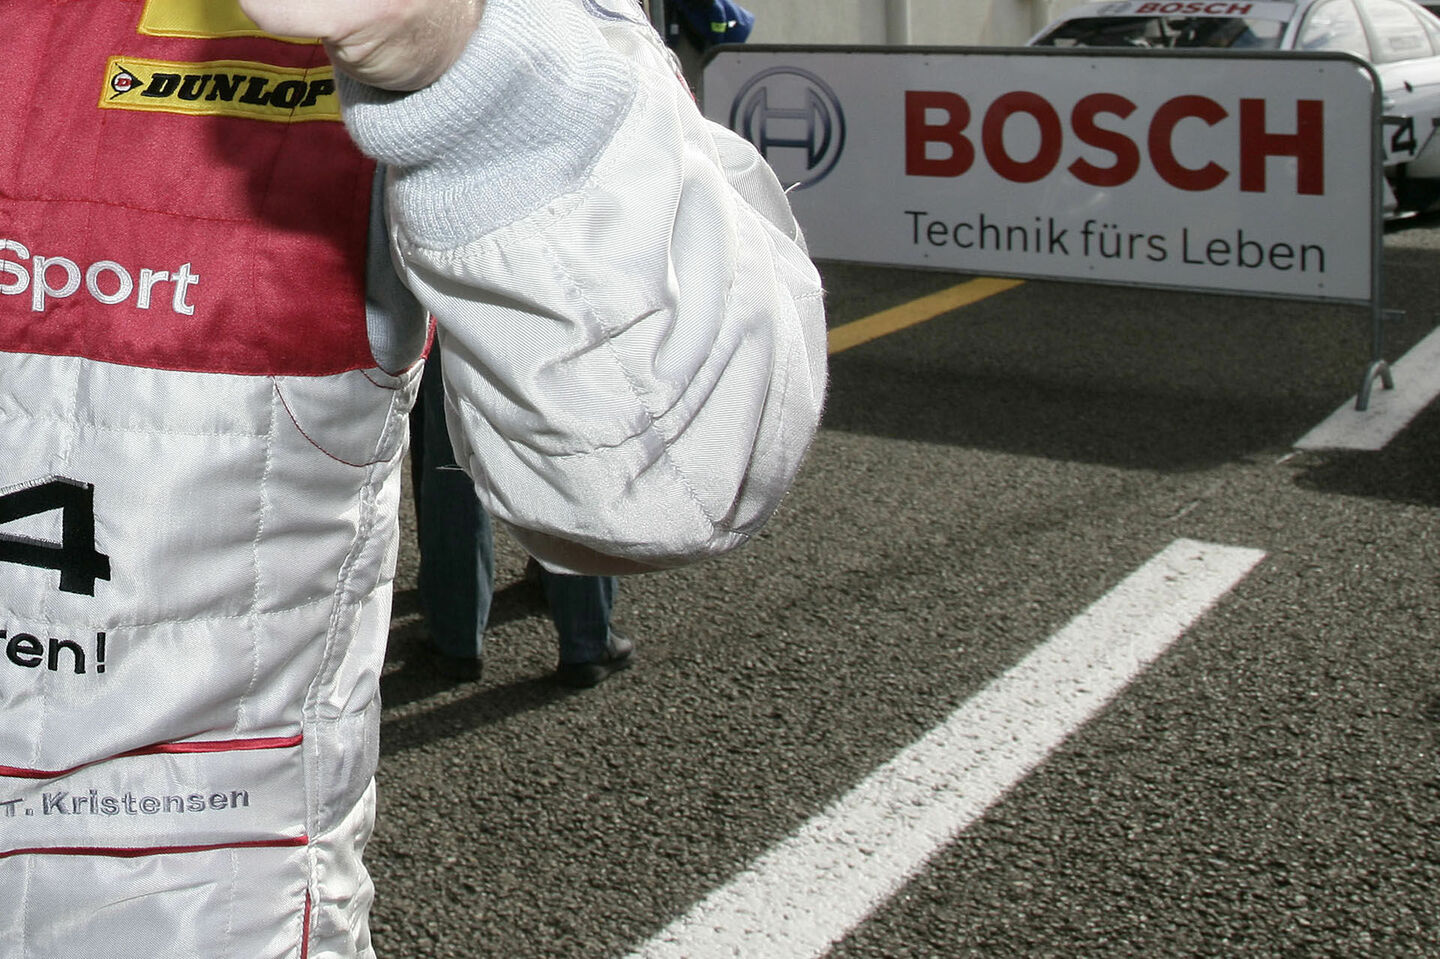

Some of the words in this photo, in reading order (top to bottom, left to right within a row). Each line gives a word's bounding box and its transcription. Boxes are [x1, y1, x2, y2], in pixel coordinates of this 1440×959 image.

[1135, 1, 1253, 15] BOSCH
[141, 72, 336, 109] DUNLOP
[904, 90, 1325, 196] BOSCH
[904, 210, 1069, 256] Technik
[1081, 219, 1168, 262] fürs
[1182, 227, 1326, 273] Leben
[42, 788, 250, 817] Kristensen
